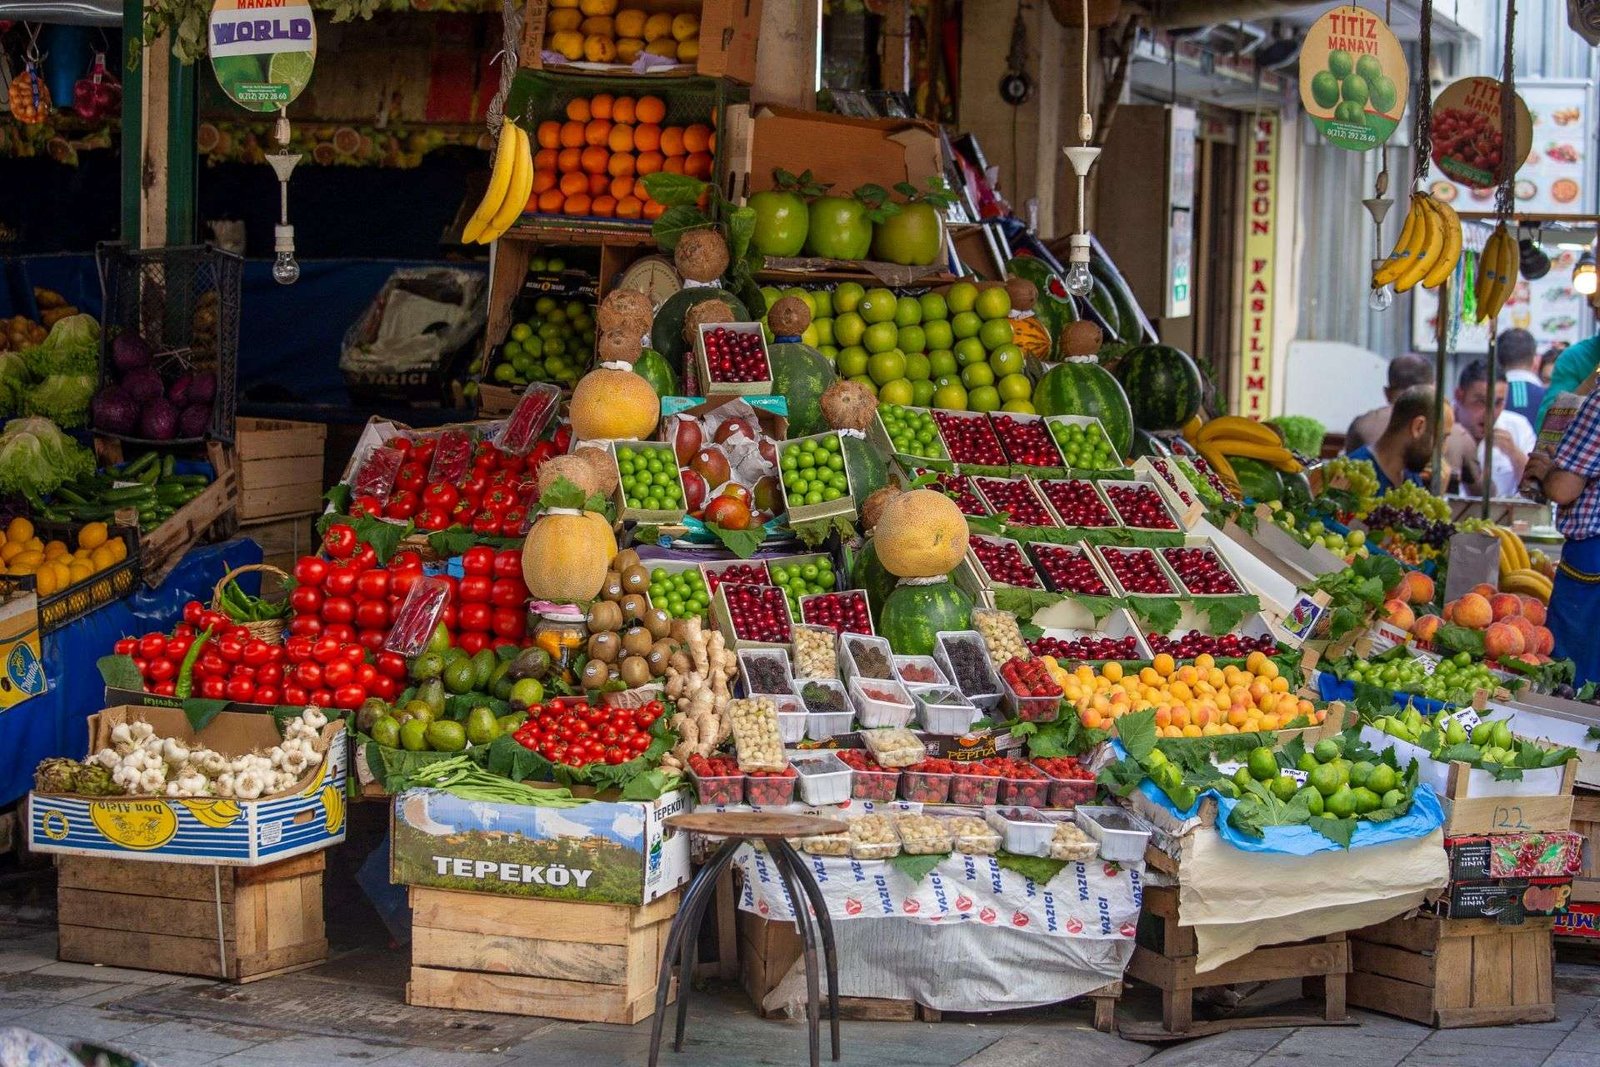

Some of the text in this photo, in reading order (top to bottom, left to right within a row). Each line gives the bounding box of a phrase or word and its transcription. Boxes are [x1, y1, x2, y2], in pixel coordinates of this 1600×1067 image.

[213, 18, 312, 46] WORLD
[1329, 9, 1377, 39] TİTİZ
[1328, 36, 1378, 56] MANAVI
[1464, 95, 1500, 117] MANA
[1472, 80, 1502, 104] TİT
[21, 660, 39, 694] Chiquita
[135, 803, 163, 815] Don
[653, 796, 687, 822] TEPEKÖY
[1492, 806, 1534, 830] 122
[432, 855, 595, 889] TEPEKÖY
[811, 855, 828, 882] YAZI
[964, 855, 977, 881] YAZI
[1076, 861, 1090, 902] YAZICI
[874, 875, 893, 914] YAZICI
[929, 873, 949, 913] YAZICI
[1043, 891, 1058, 932] YAZICI
[1098, 896, 1112, 936] YAZICI
